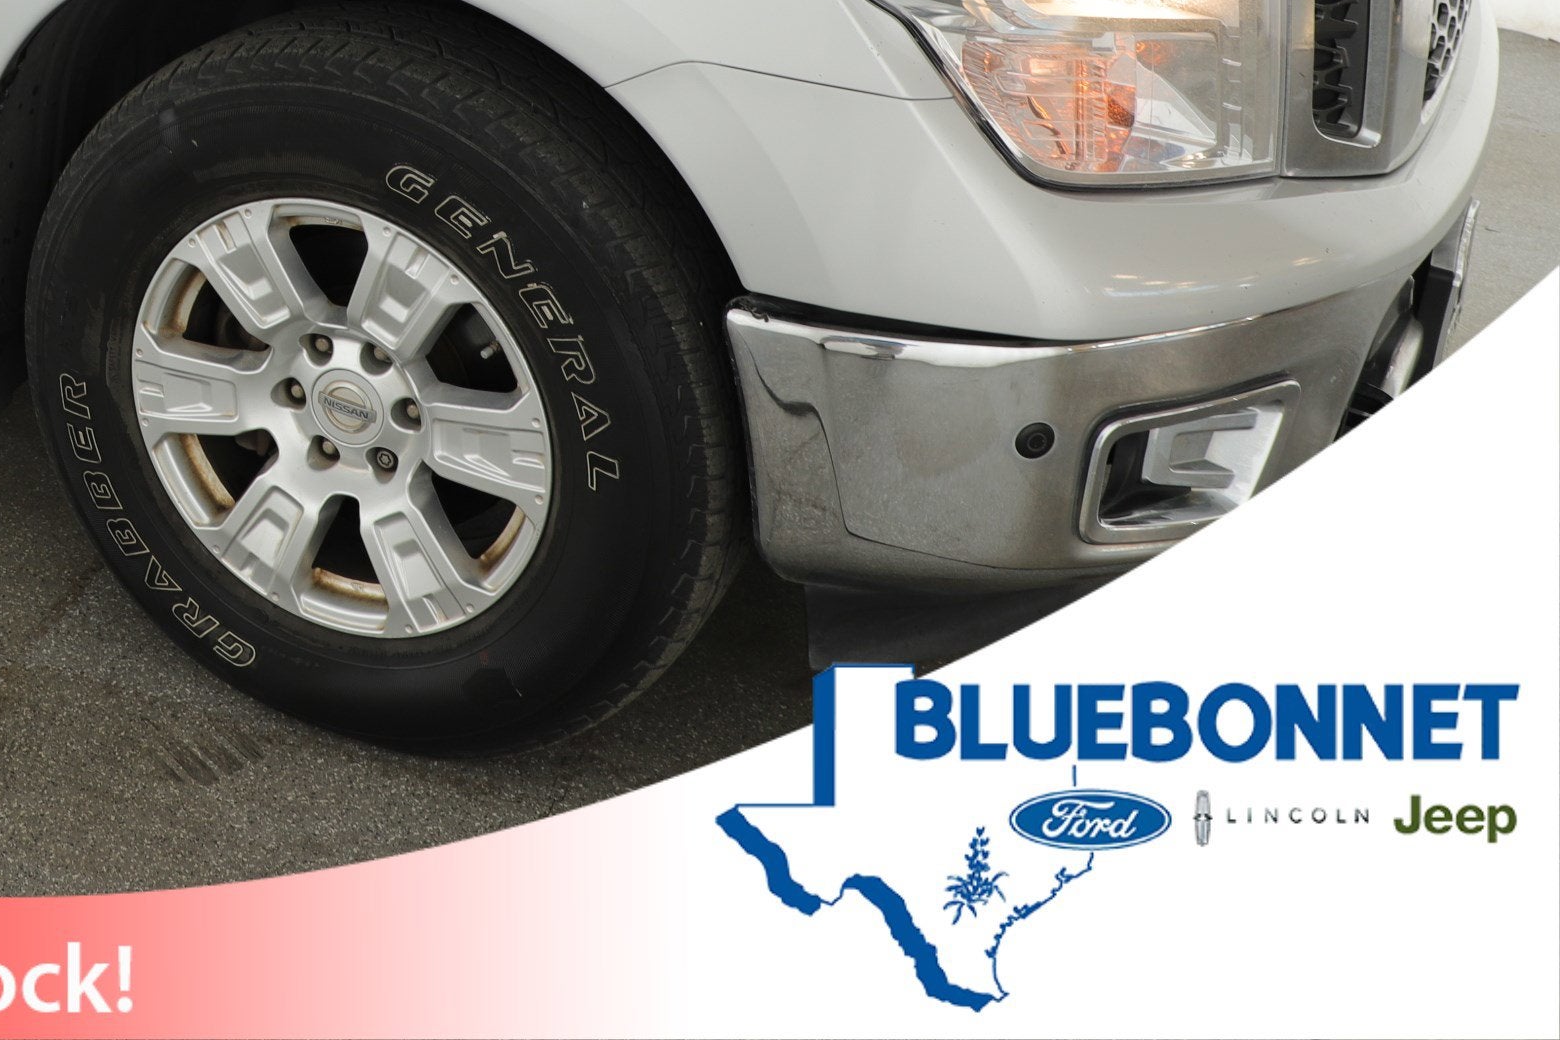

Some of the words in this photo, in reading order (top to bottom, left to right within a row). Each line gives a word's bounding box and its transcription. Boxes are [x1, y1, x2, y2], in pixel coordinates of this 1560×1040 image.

[323, 396, 369, 419] NISSAN
[385, 163, 620, 491] GENERAL
[59, 372, 256, 667] GRABBER
